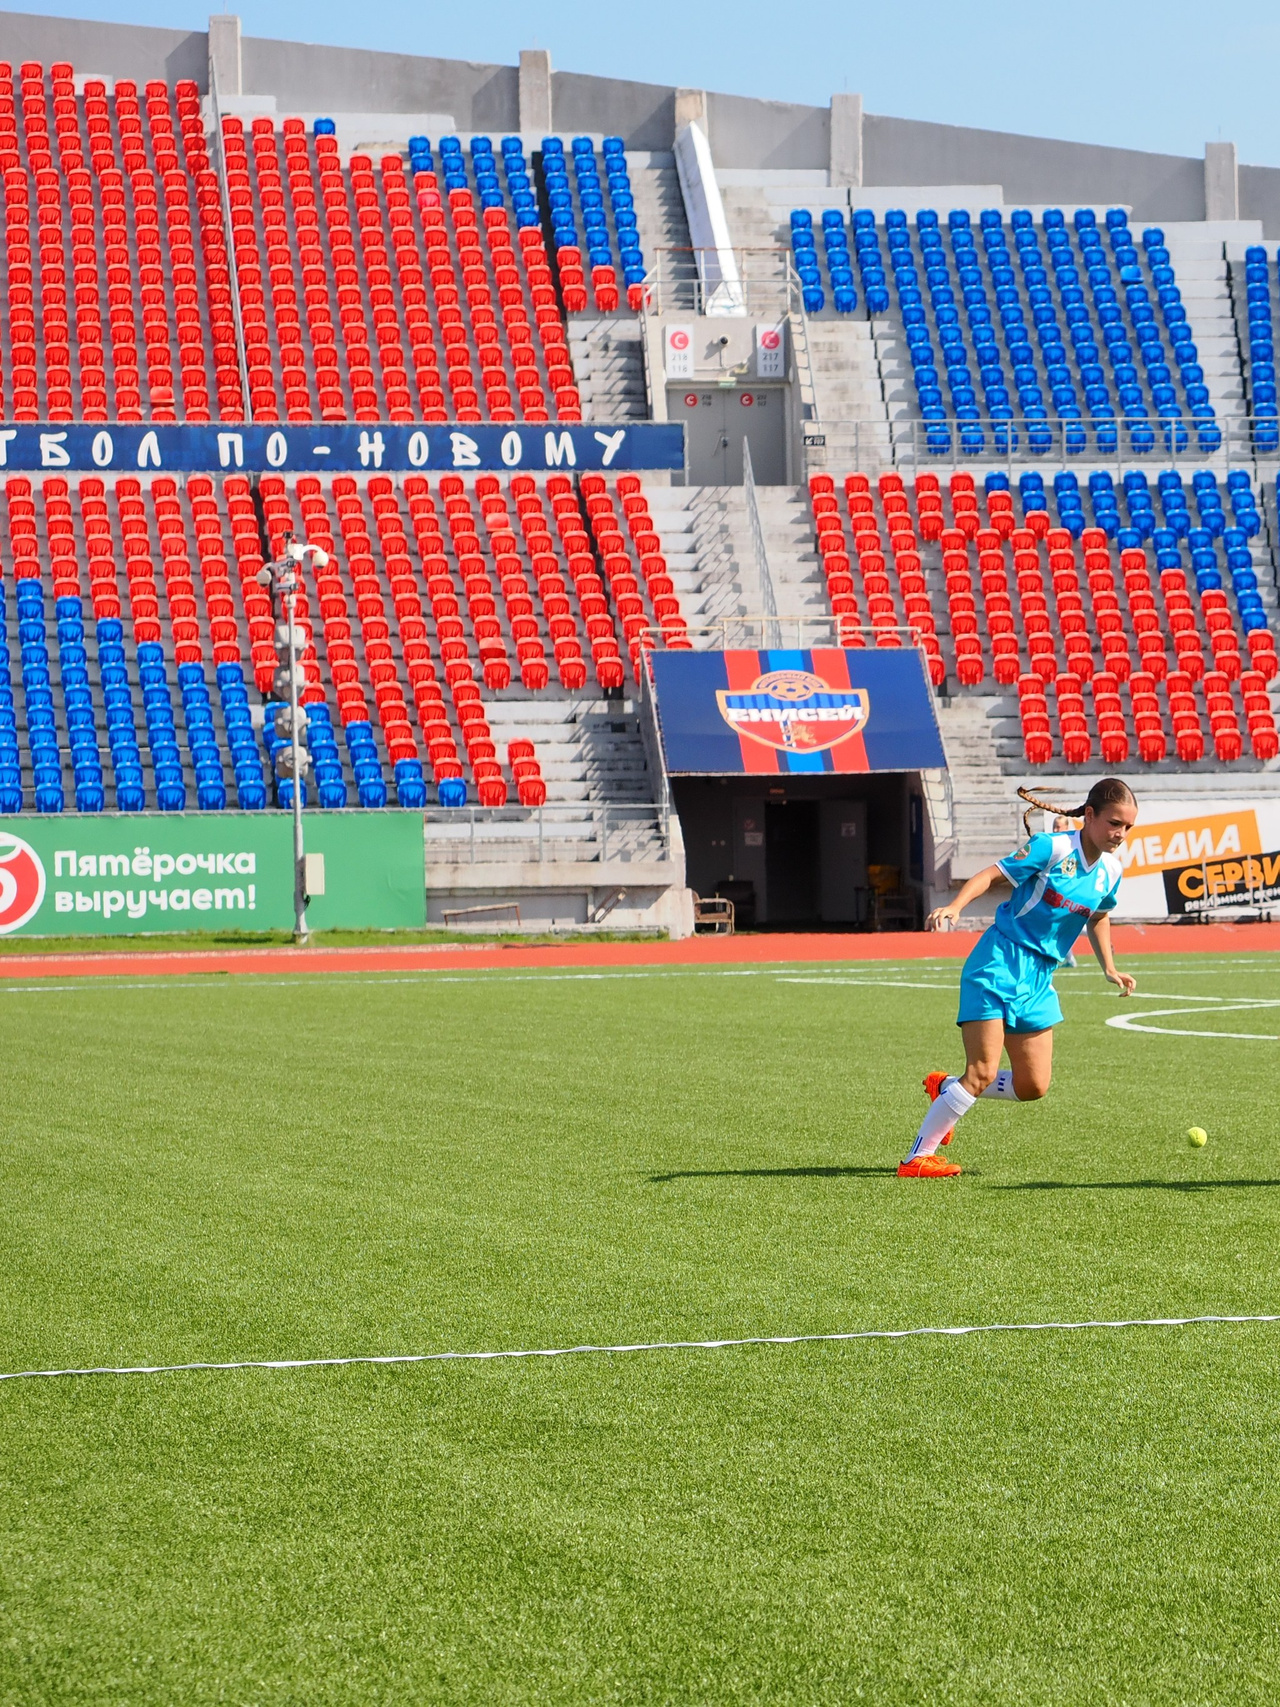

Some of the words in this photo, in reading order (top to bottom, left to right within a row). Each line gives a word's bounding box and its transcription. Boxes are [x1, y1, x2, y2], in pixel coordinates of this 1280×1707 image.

[672, 353, 688, 361] 218
[672, 364, 688, 372] 118
[763, 364, 779, 372] 117
[217, 429, 626, 468] ПО-НОВОМУ
[726, 704, 866, 723] ЕНИСЕЙ
[1113, 824, 1241, 869] МЕДИА
[54, 846, 256, 883] Пятёрочка
[1094, 867, 1106, 893] 2
[54, 884, 256, 918] выручает!
